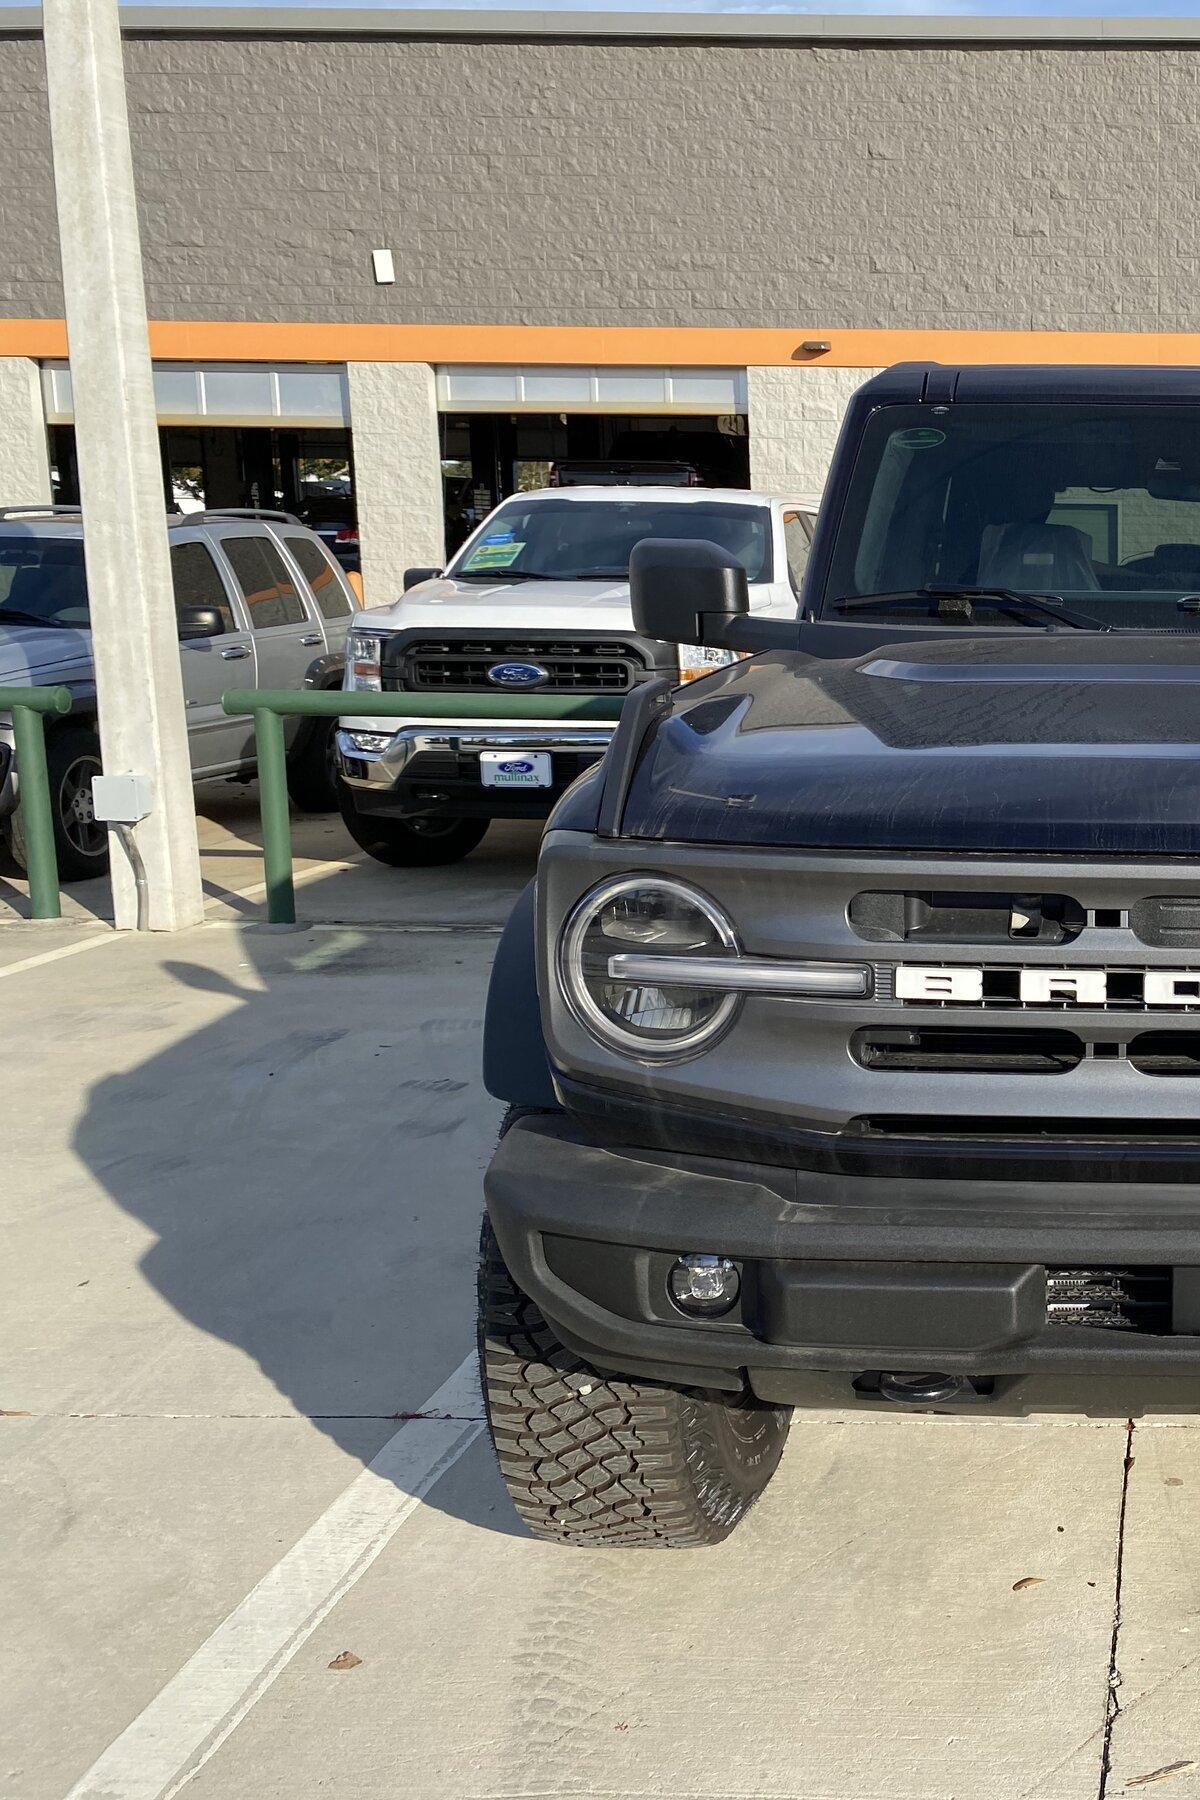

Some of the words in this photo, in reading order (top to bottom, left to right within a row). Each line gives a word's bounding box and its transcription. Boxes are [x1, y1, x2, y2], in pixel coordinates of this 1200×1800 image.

[500, 667, 530, 681] Ford
[504, 762, 528, 773] Ford
[494, 772, 540, 782] mullinax
